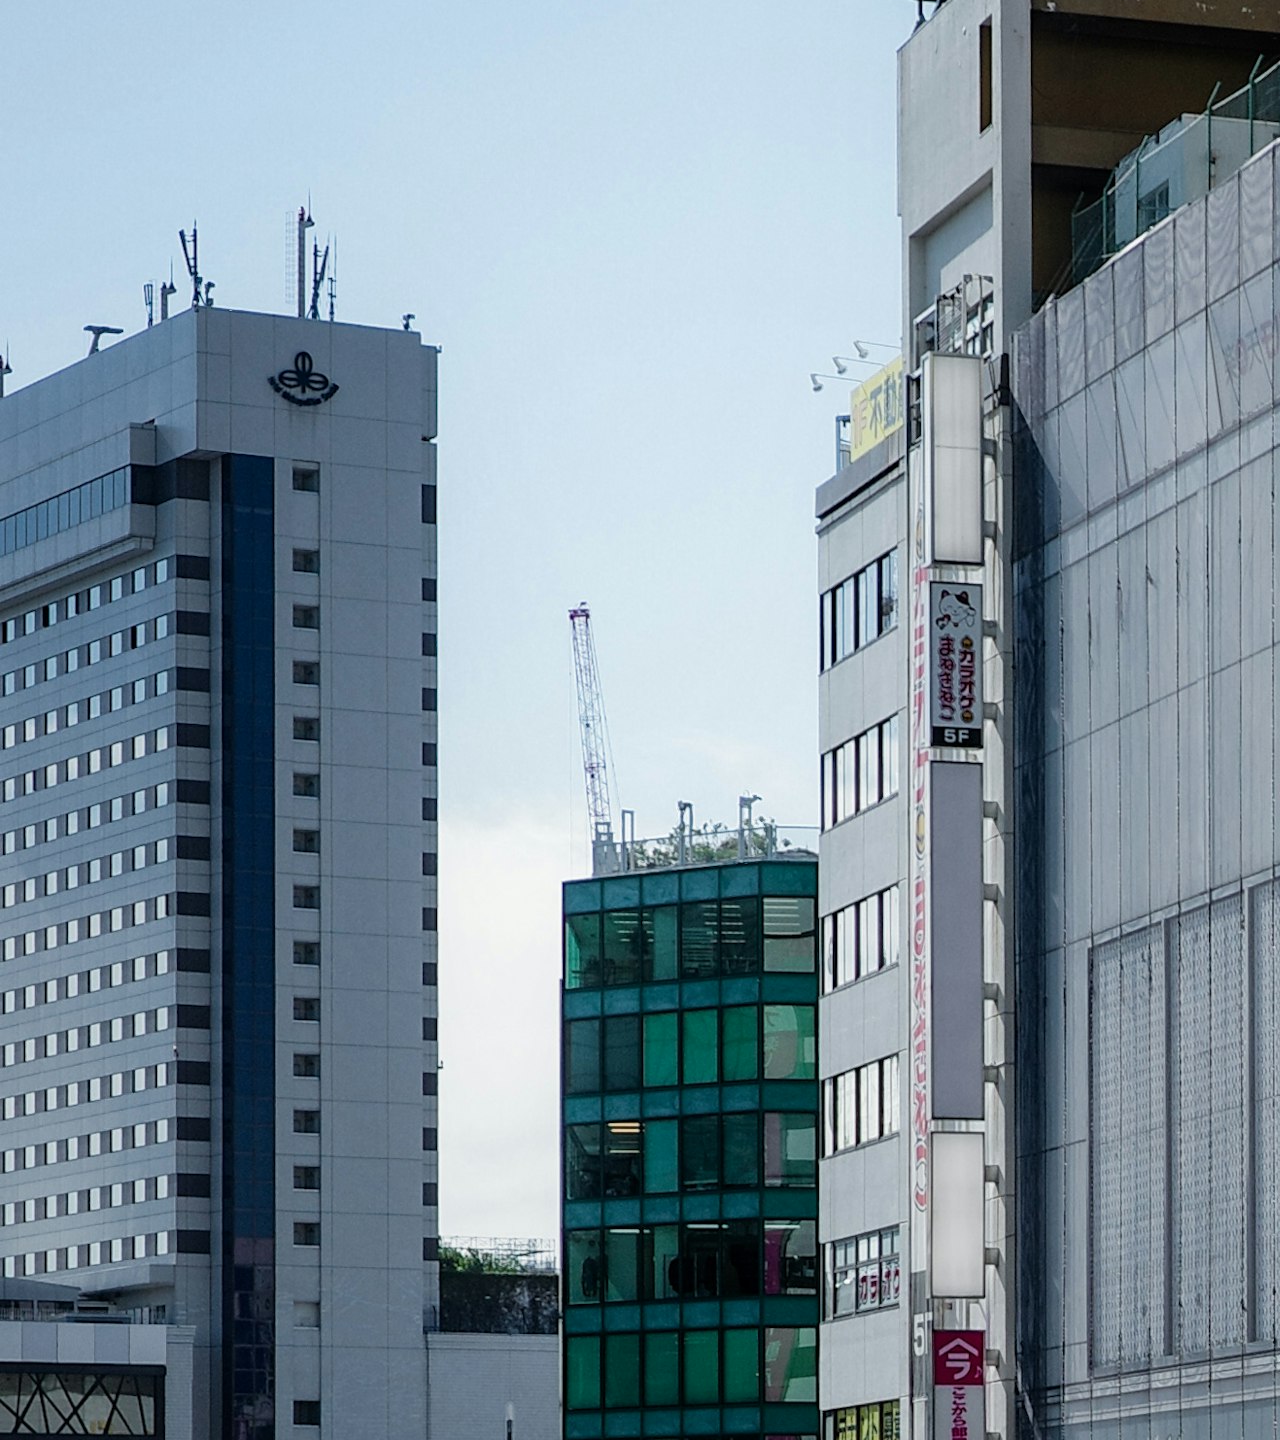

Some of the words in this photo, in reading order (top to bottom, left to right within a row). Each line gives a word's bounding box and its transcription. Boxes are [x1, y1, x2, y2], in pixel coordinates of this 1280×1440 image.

[869, 365, 903, 441] 不動
[958, 646, 976, 712] カラオケ
[943, 728, 970, 745] 5F
